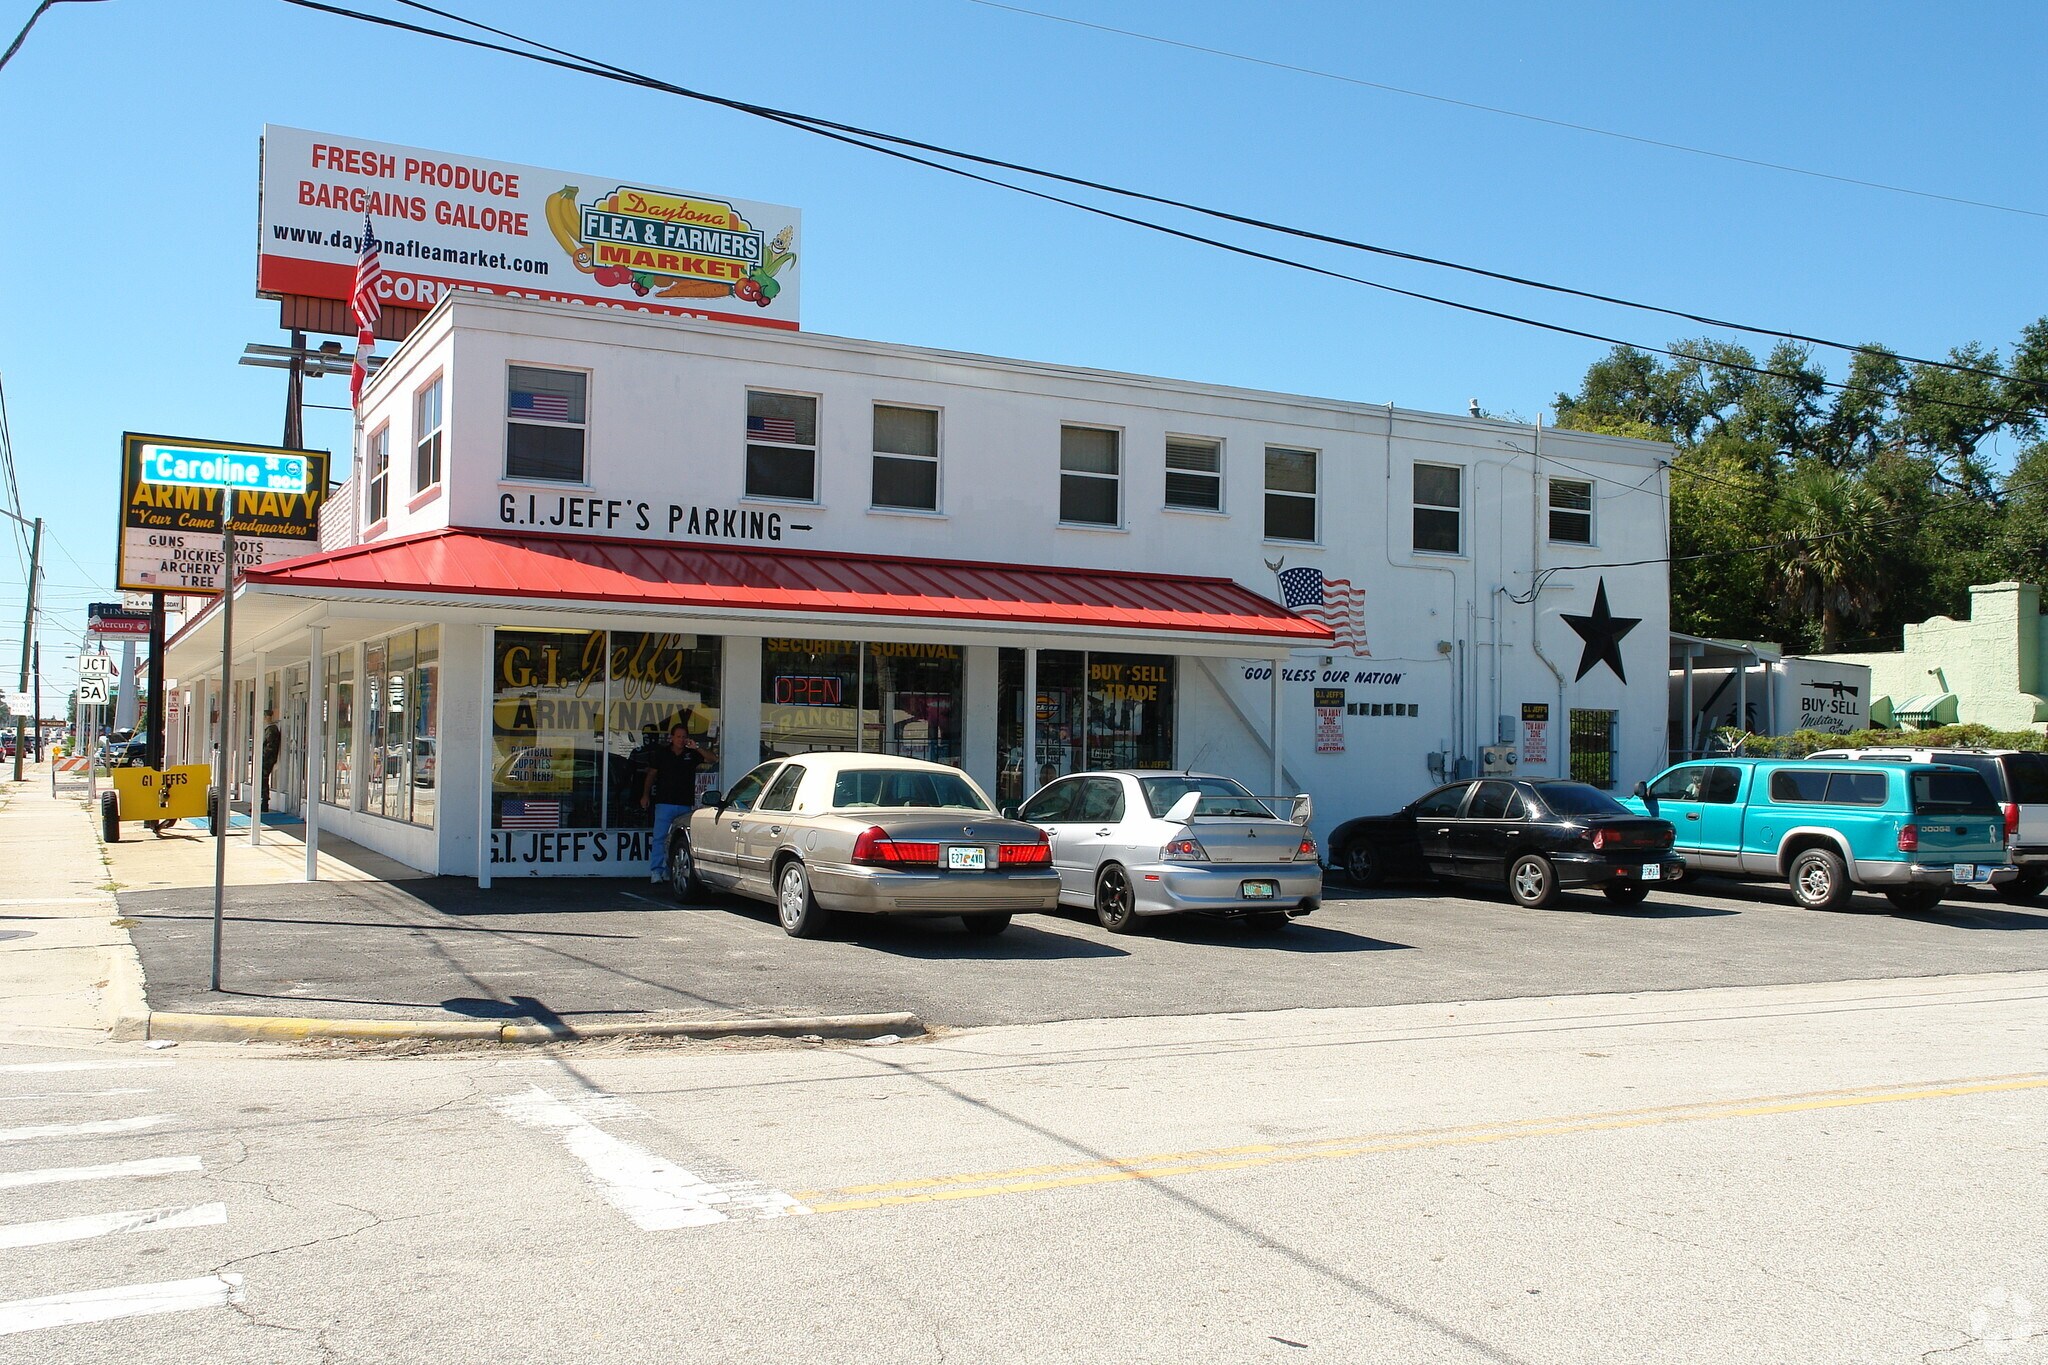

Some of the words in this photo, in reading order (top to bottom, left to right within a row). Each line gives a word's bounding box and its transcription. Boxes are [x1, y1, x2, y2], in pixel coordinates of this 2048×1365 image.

[312, 144, 395, 178] FRESH
[404, 158, 519, 198] PRODUCE
[298, 180, 426, 221] BARGAINS
[434, 200, 528, 236] GALORE
[624, 193, 726, 225] Daytona
[587, 214, 638, 242] FLEA
[643, 223, 658, 245] &
[664, 225, 758, 259] FARMERS
[273, 225, 549, 275] www.dayonafleamarket.com
[600, 246, 745, 279] MARKET
[156, 452, 260, 484] Caroline
[264, 456, 280, 471] St
[177, 512, 215, 528] Camo
[668, 505, 781, 541] PARKING
[149, 535, 185, 547] GUNS
[222, 541, 264, 553] OOTS
[174, 549, 225, 563] DICKIES
[234, 553, 263, 565] KIDS
[160, 561, 221, 575] ARCHERY
[95, 621, 135, 631] Mercury
[767, 638, 854, 654] SECURITY
[870, 641, 959, 659] SURVIVAL
[83, 658, 107, 671] JCT
[503, 645, 569, 690] G.I.
[575, 630, 684, 700] Jeff's
[1091, 664, 1123, 680] BUY
[1131, 665, 1168, 682] SELL
[1322, 670, 1350, 683] OUR
[81, 686, 102, 699] 5A
[777, 677, 839, 704] OPEN
[1105, 684, 1157, 701] TRADE
[1800, 712, 1844, 729] Military
[142, 774, 153, 787] GI
[161, 773, 188, 786] JEFFS
[1921, 825, 1951, 833] DODGE
[522, 831, 608, 863] JEFF'S
